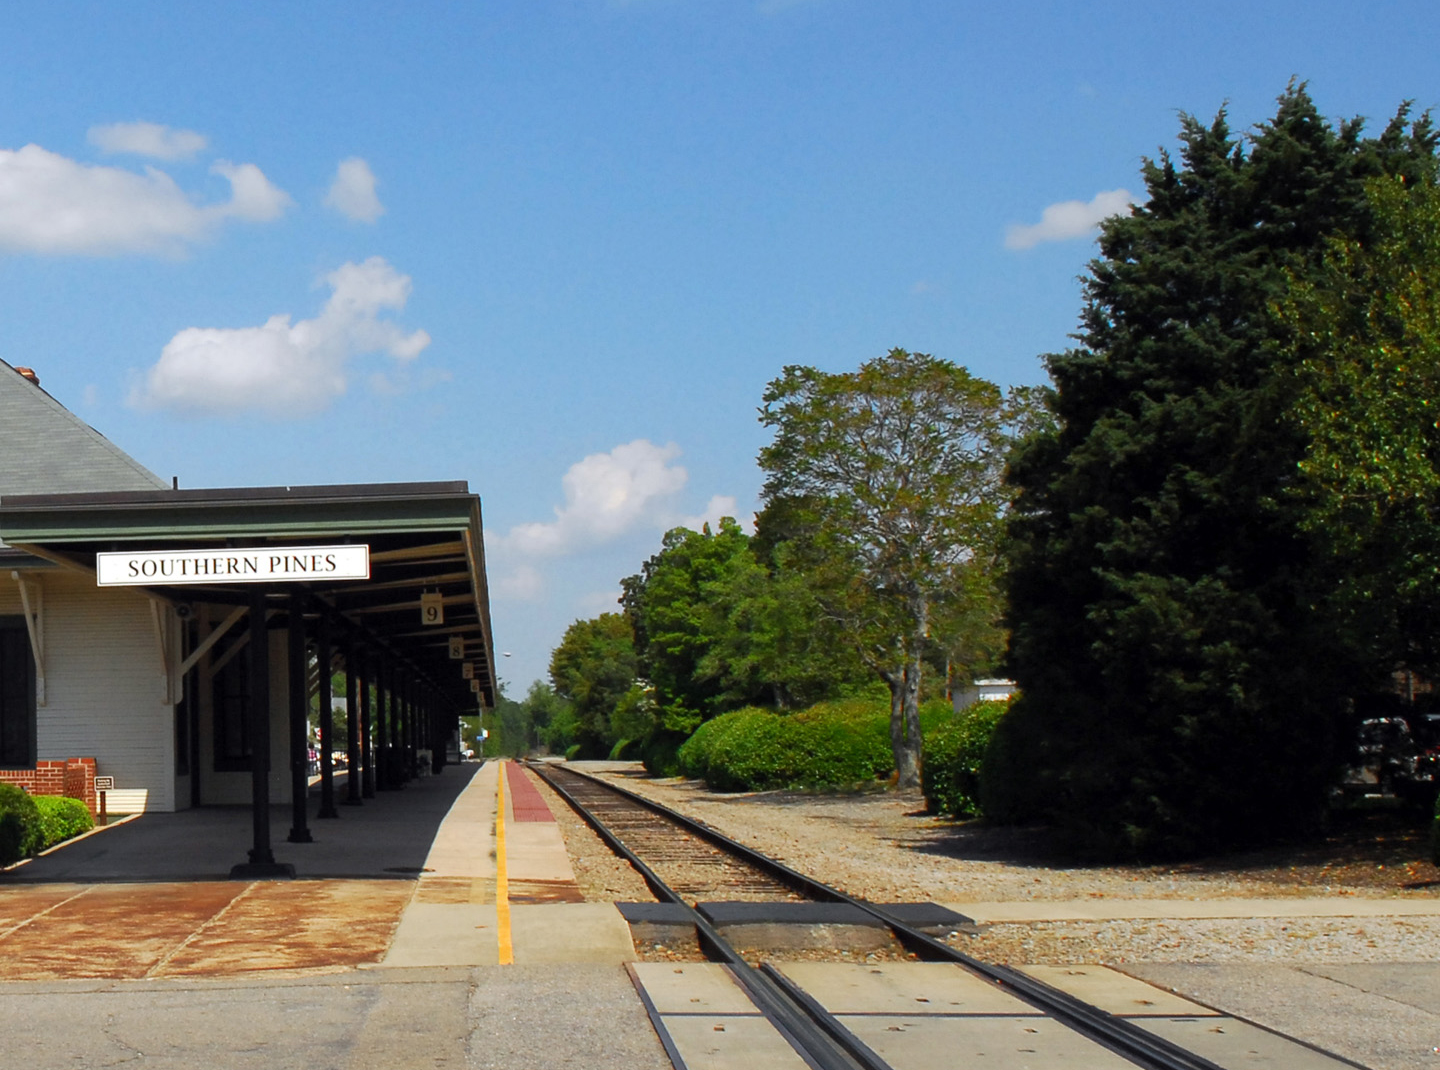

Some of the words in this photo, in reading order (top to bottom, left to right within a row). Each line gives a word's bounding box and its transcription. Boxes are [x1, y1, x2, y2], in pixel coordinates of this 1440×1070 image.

[128, 556, 258, 577] SOUTHERN
[268, 554, 336, 573] PINES
[427, 606, 438, 622] 9
[453, 646, 460, 657] 8
